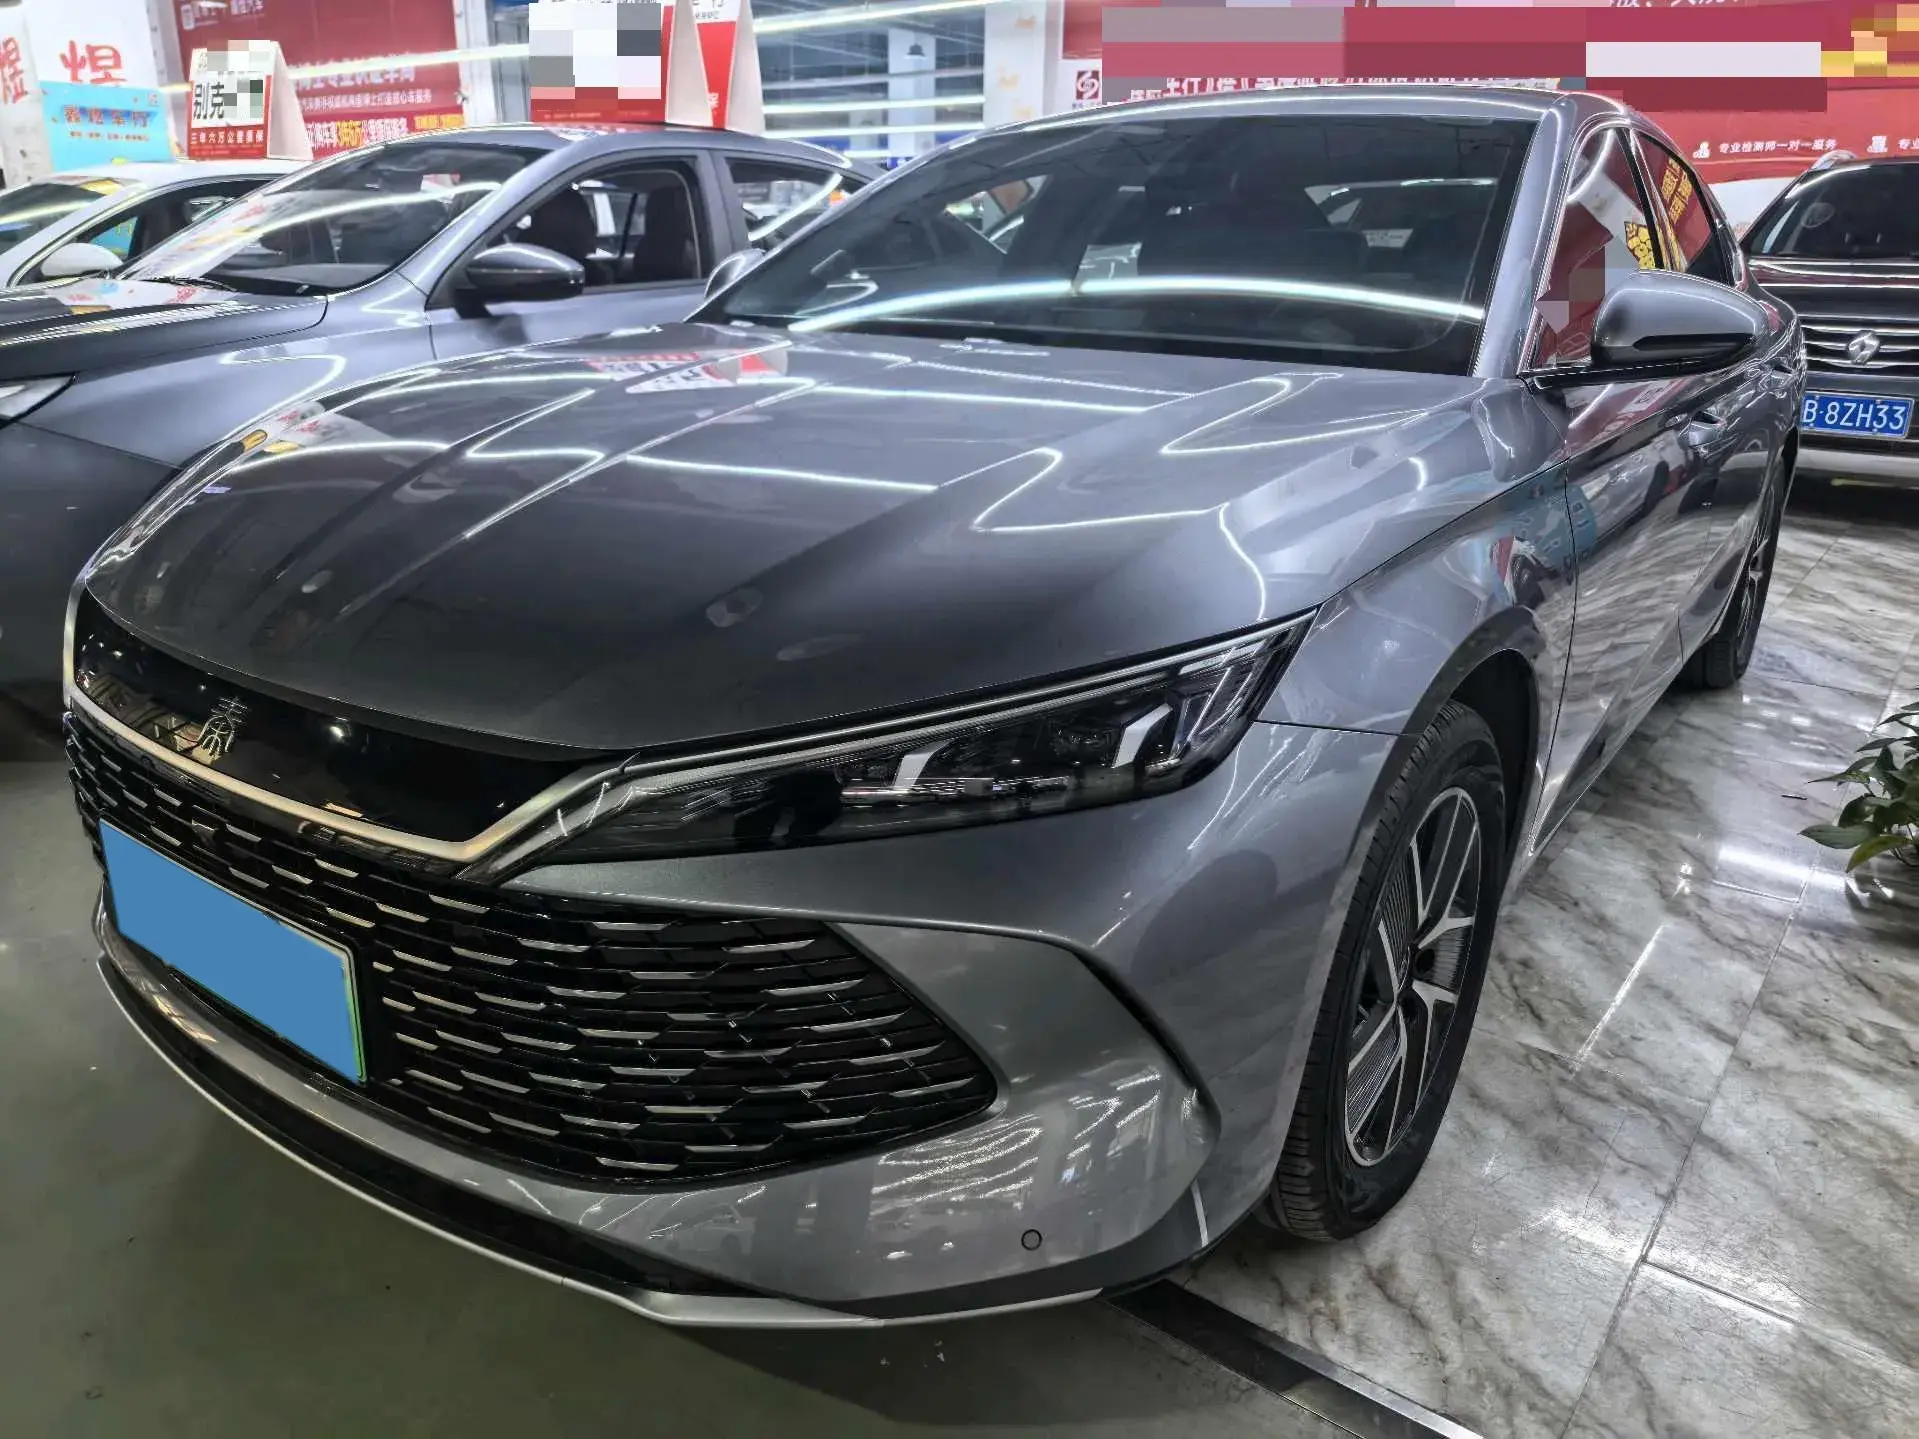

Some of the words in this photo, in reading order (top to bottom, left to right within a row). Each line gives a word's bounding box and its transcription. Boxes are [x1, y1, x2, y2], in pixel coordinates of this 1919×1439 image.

[1719, 138, 1837, 154] 专业检测师一对一服务
